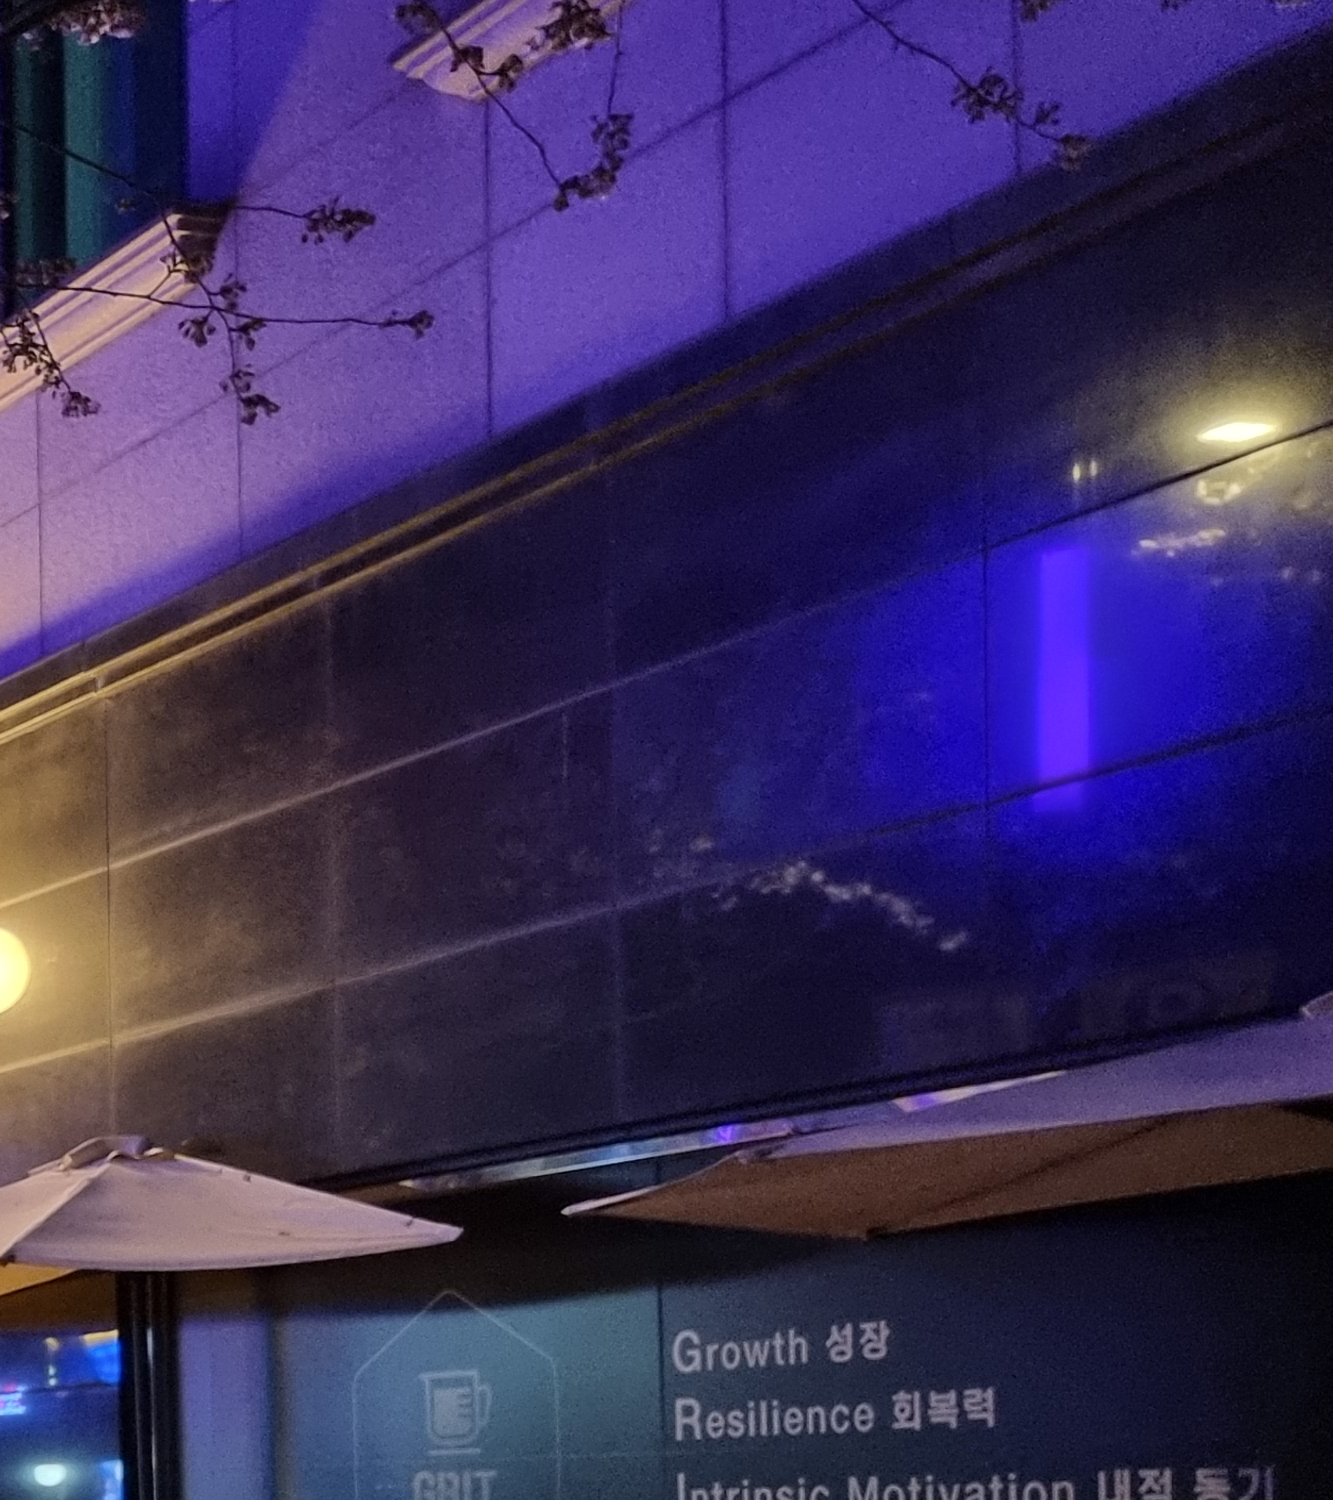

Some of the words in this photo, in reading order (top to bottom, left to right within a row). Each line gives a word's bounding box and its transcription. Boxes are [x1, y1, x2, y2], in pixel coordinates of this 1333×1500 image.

[672, 1328, 809, 1374] Growth
[824, 1319, 891, 1363] 성장
[674, 1396, 876, 1441] Resilience
[891, 1386, 996, 1431] 회복력
